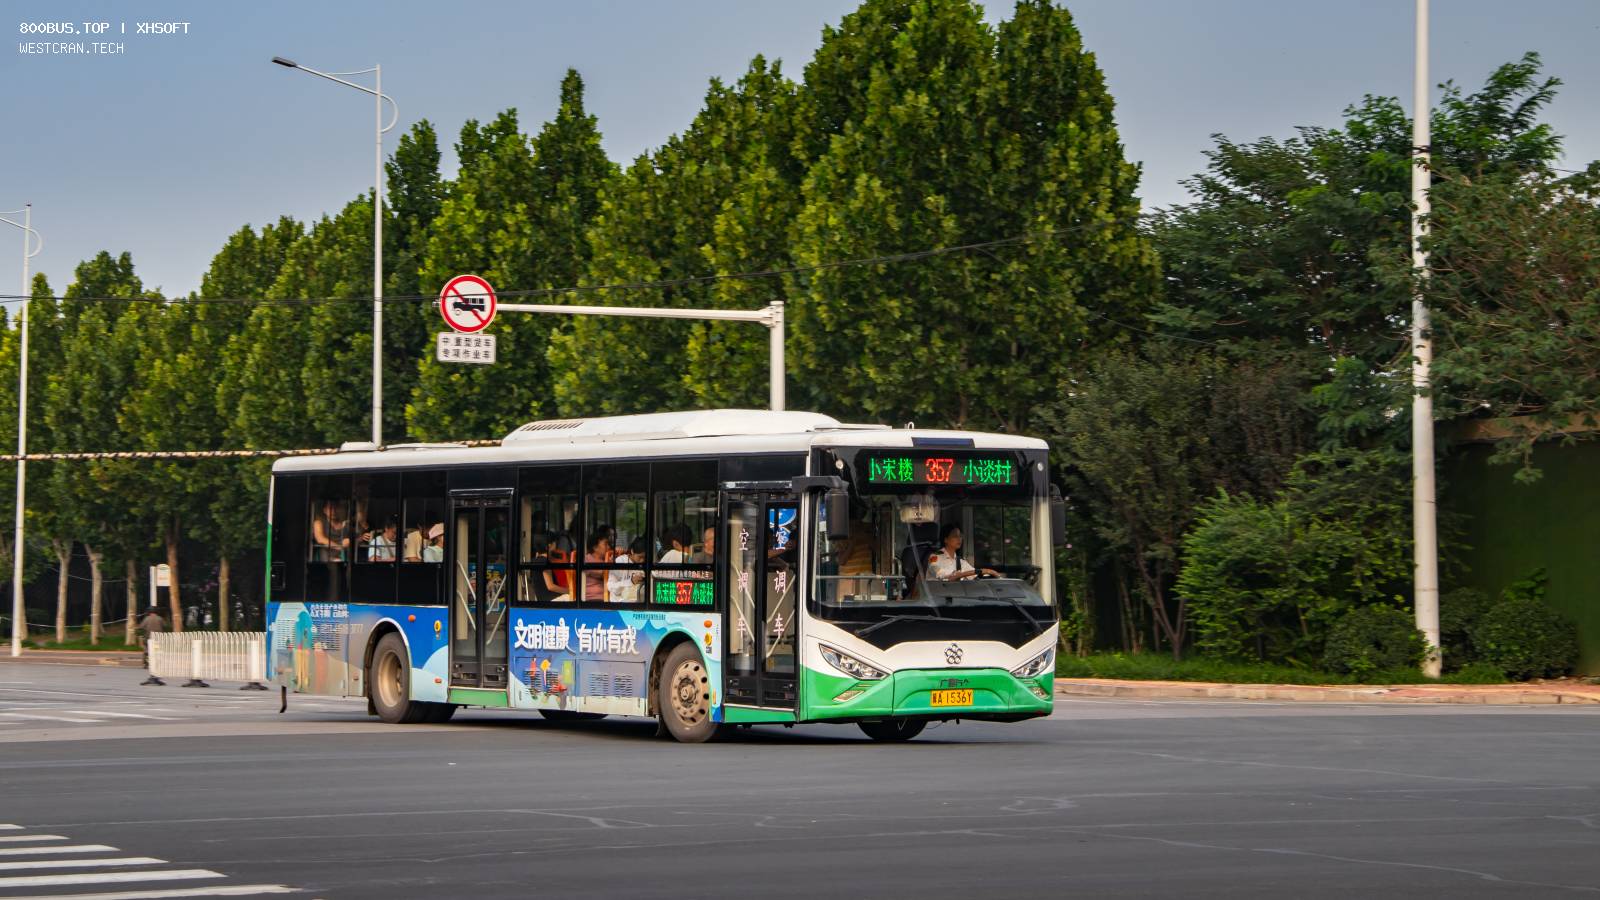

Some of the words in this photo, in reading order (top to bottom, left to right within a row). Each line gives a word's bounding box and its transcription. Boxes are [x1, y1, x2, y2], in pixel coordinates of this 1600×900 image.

[925, 458, 954, 482] 357
[963, 459, 1012, 483] 小谈村
[676, 582, 693, 604] 357
[773, 528, 787, 639] 空调车
[514, 617, 576, 655] 文明健康
[575, 618, 639, 655] 有你有我
